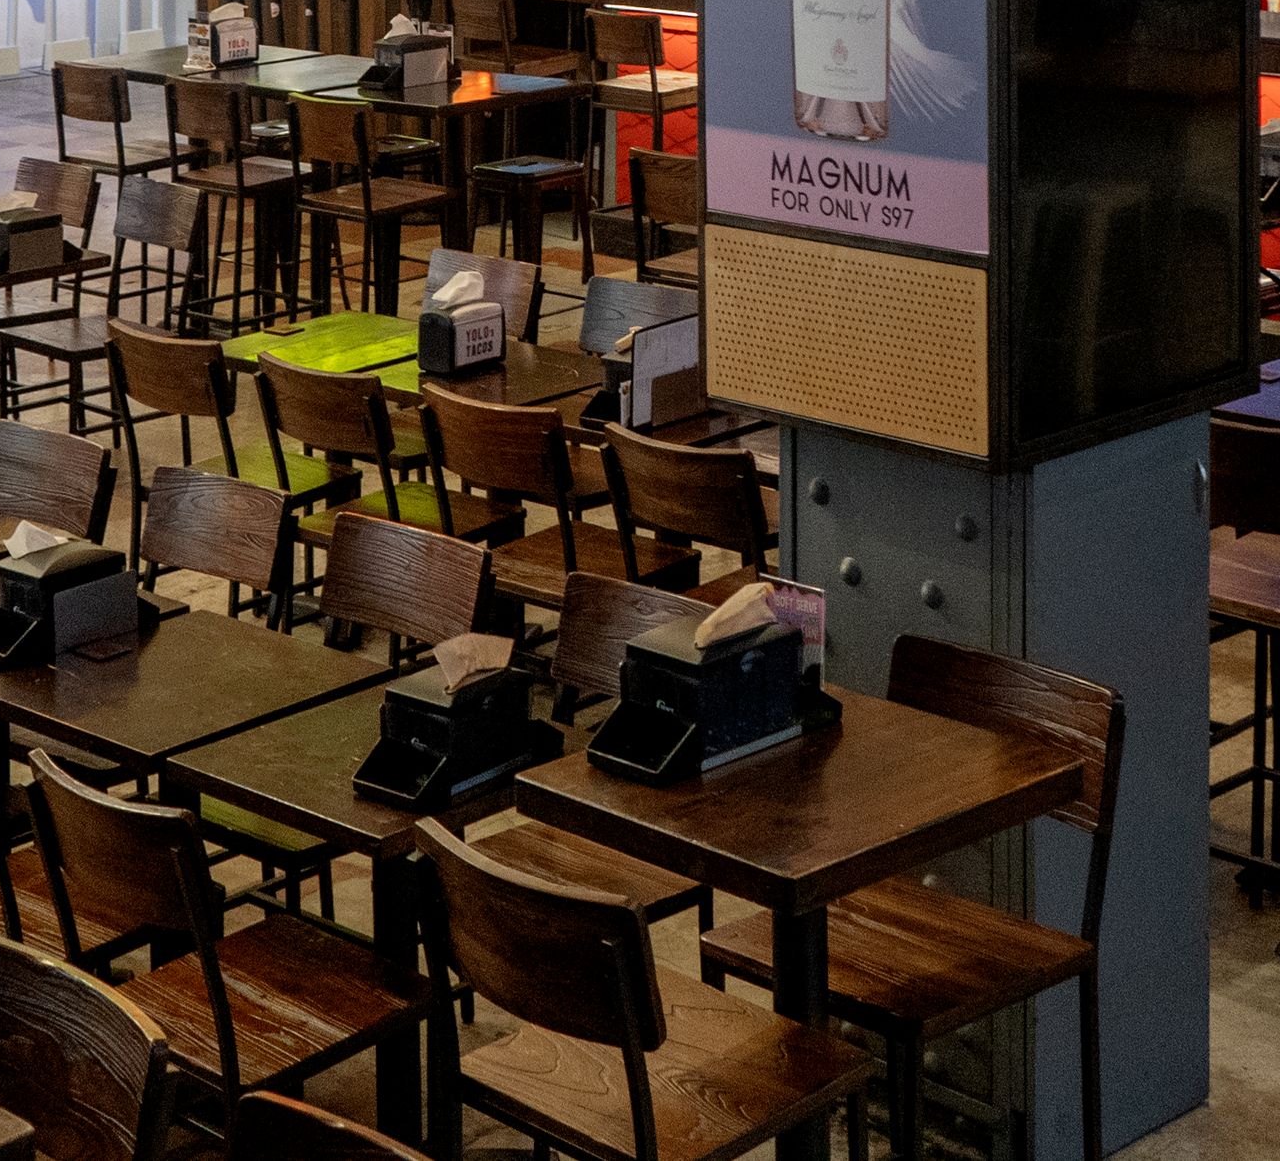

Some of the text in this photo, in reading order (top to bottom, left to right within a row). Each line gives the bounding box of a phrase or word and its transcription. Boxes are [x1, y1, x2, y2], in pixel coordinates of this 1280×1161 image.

[770, 150, 911, 201] MAGNUM
[771, 188, 914, 230] FOR ONLY $97
[466, 340, 493, 357] TACOS
